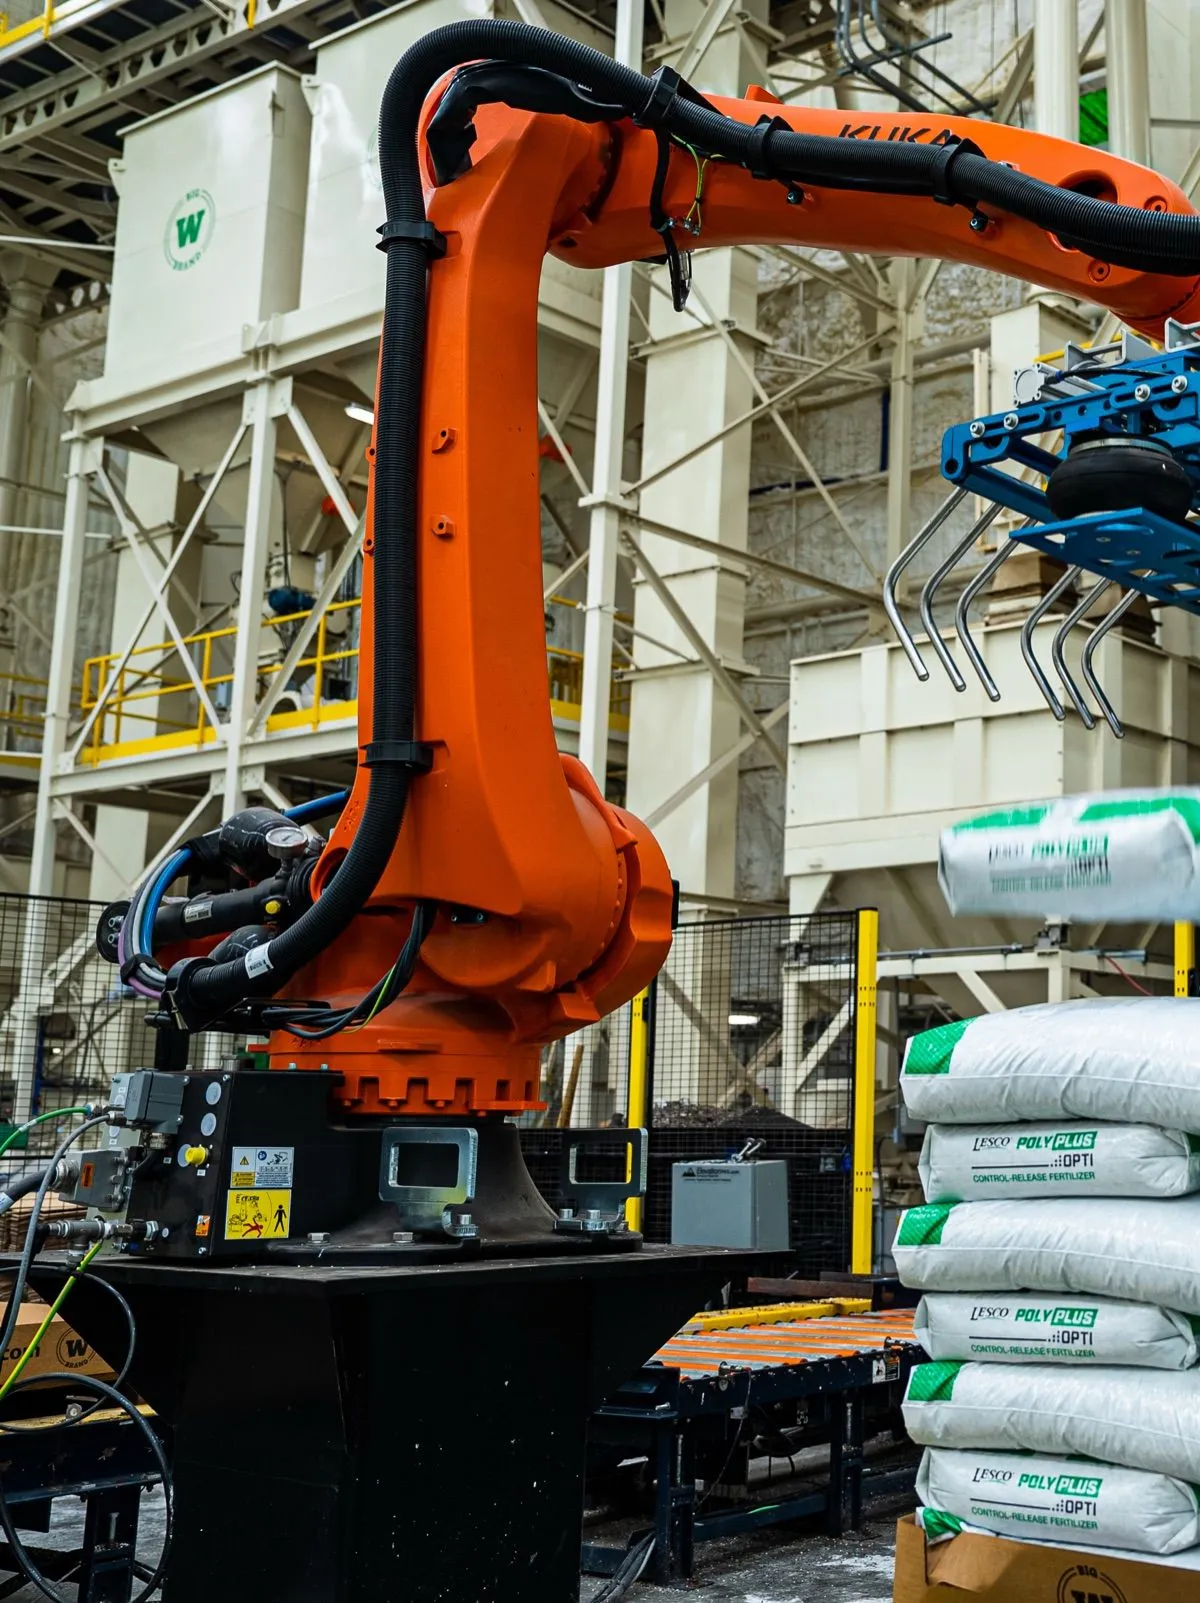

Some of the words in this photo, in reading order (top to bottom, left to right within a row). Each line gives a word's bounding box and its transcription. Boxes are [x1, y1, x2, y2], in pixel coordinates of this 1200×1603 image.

[176, 208, 205, 248] W
[972, 1137, 1010, 1151] LESCO
[1063, 1153, 1093, 1167] OPTI
[1049, 1171, 1095, 1181] FERTILIZER
[970, 1307, 1009, 1321] LESCO
[1061, 1330, 1093, 1345] OPTI
[66, 1339, 88, 1358] W
[1046, 1348, 1096, 1358] FERTILIZER
[972, 1468, 1012, 1482] LESCO
[1065, 1500, 1097, 1516] OPTI
[1050, 1517, 1098, 1530] FERTILIZER
